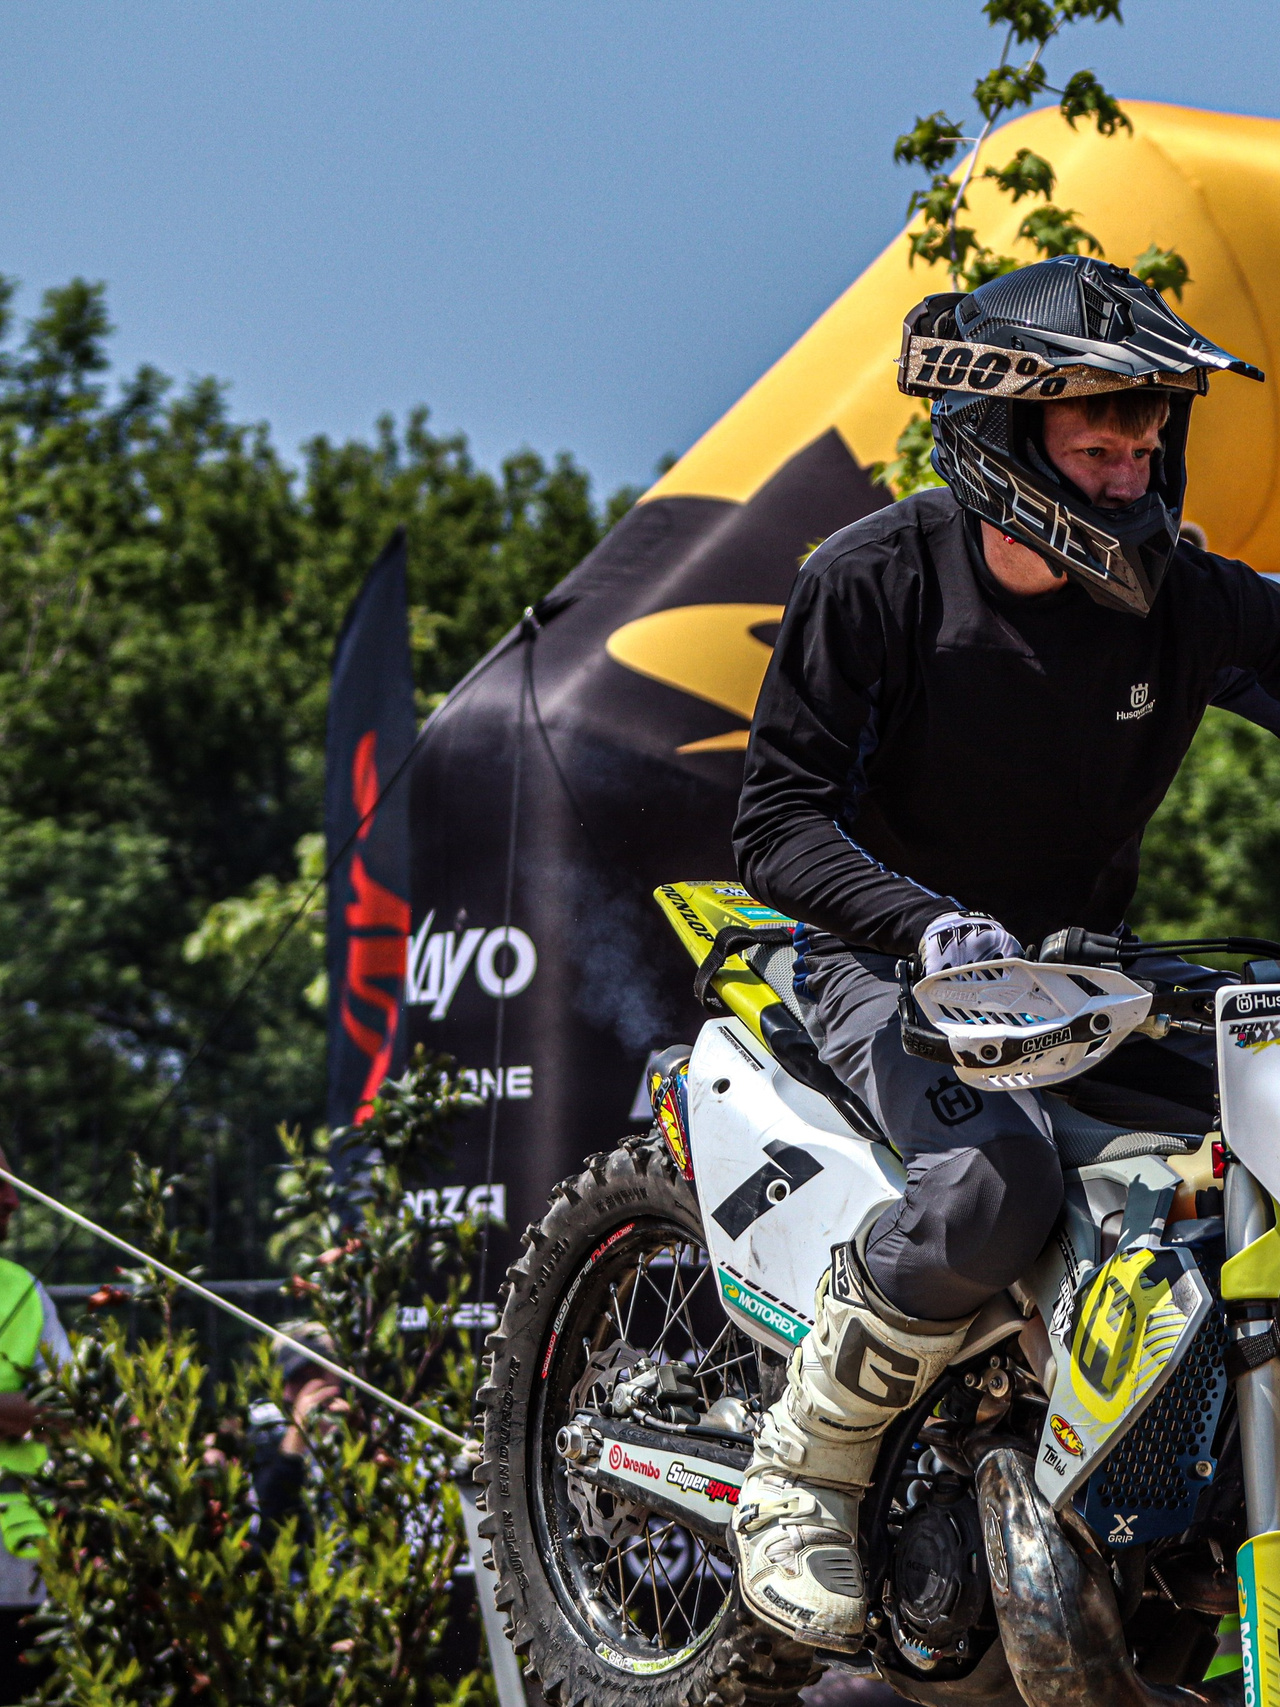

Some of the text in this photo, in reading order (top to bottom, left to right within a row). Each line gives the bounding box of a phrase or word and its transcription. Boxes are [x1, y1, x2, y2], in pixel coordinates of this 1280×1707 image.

[915, 345, 1068, 397] 100%
[660, 884, 715, 943] DUNLOP
[1020, 1026, 1073, 1055] CYCRA
[738, 1290, 799, 1339] MOTOREX
[622, 1454, 661, 1480] brembo
[1107, 1533, 1134, 1544] GRIP
